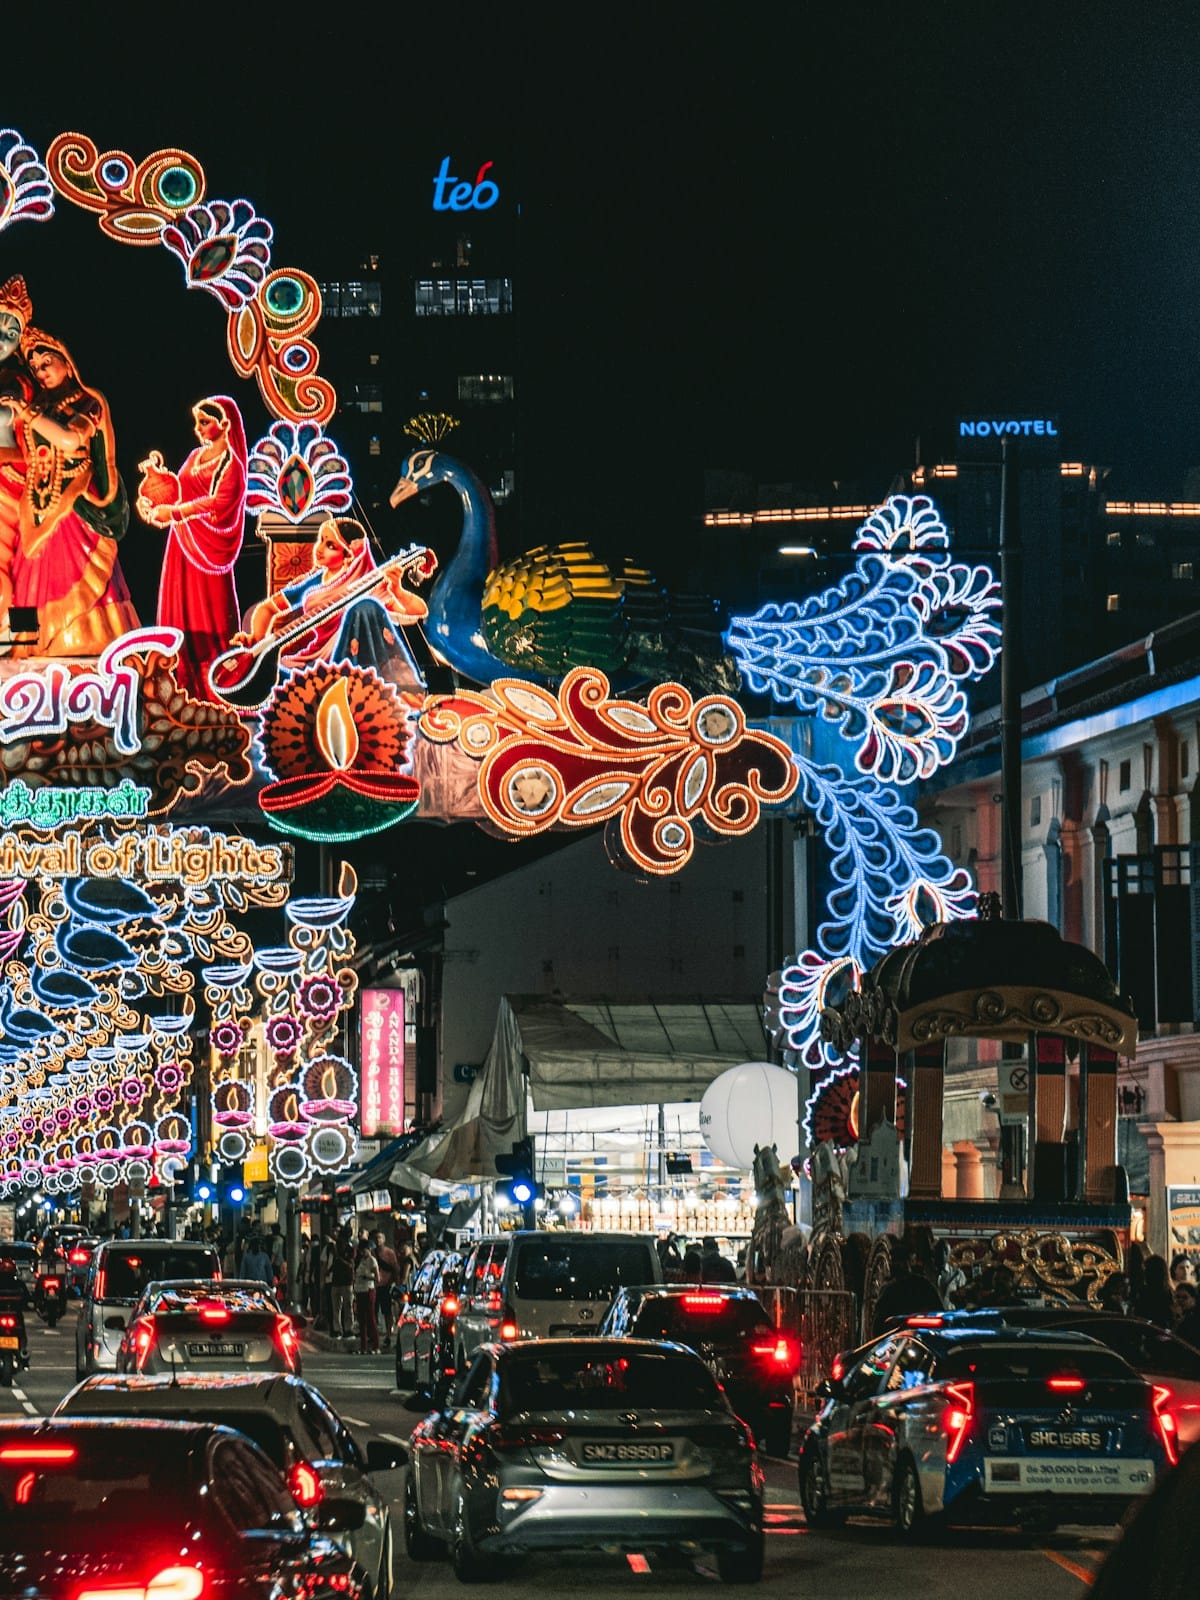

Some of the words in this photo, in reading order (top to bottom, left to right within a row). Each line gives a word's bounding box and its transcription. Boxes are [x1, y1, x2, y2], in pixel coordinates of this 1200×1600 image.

[960, 420, 1058, 437] NOVOTEL
[86, 832, 139, 879] of
[143, 833, 283, 888] Lights
[388, 1010, 399, 1064] ANANDA
[388, 1066, 400, 1121] BHAVAN
[584, 1445, 672, 1460] SMZ8950P
[1040, 1465, 1075, 1474] 30,000
[1027, 1476, 1053, 1484] closer
[1074, 1477, 1088, 1486] trip
